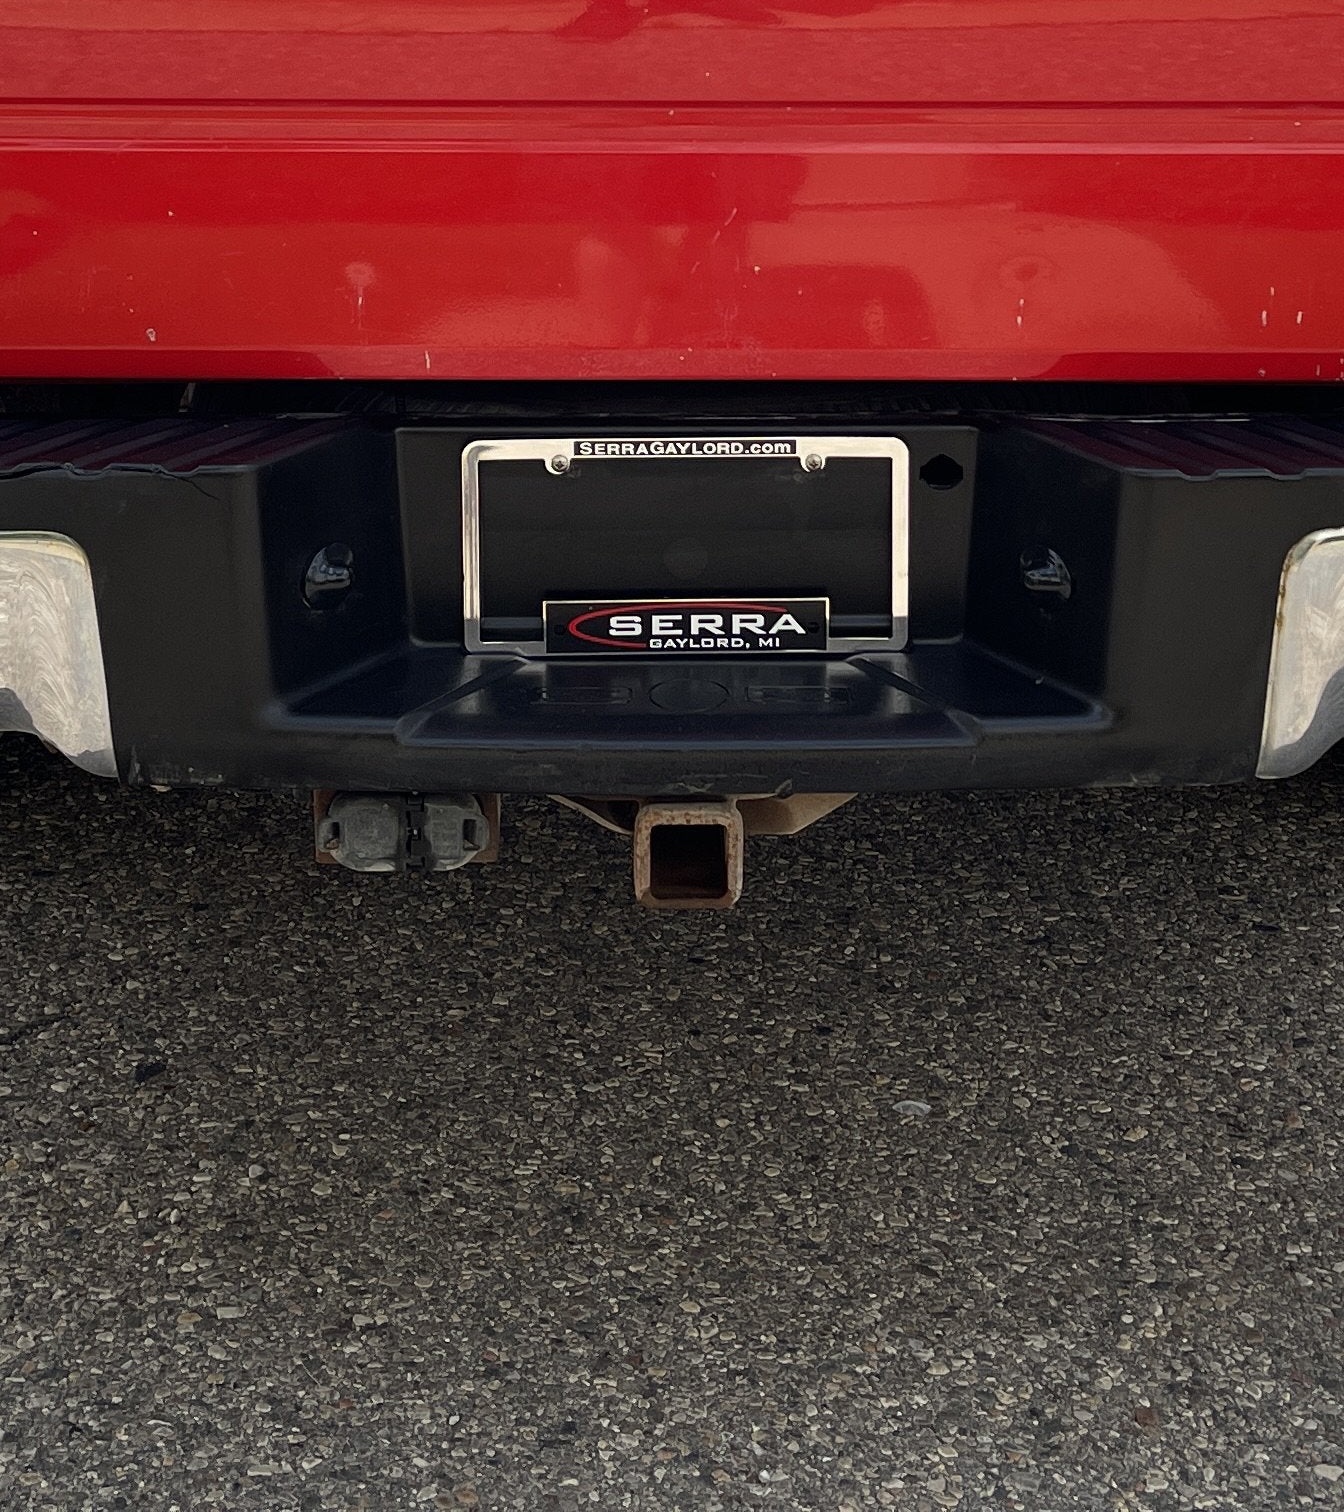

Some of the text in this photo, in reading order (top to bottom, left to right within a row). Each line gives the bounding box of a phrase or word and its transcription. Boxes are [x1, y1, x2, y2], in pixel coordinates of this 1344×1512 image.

[579, 441, 791, 455] SERRAGAYLORD.com
[608, 613, 806, 636] SERRA
[649, 638, 780, 649] GAYLORD, MI
